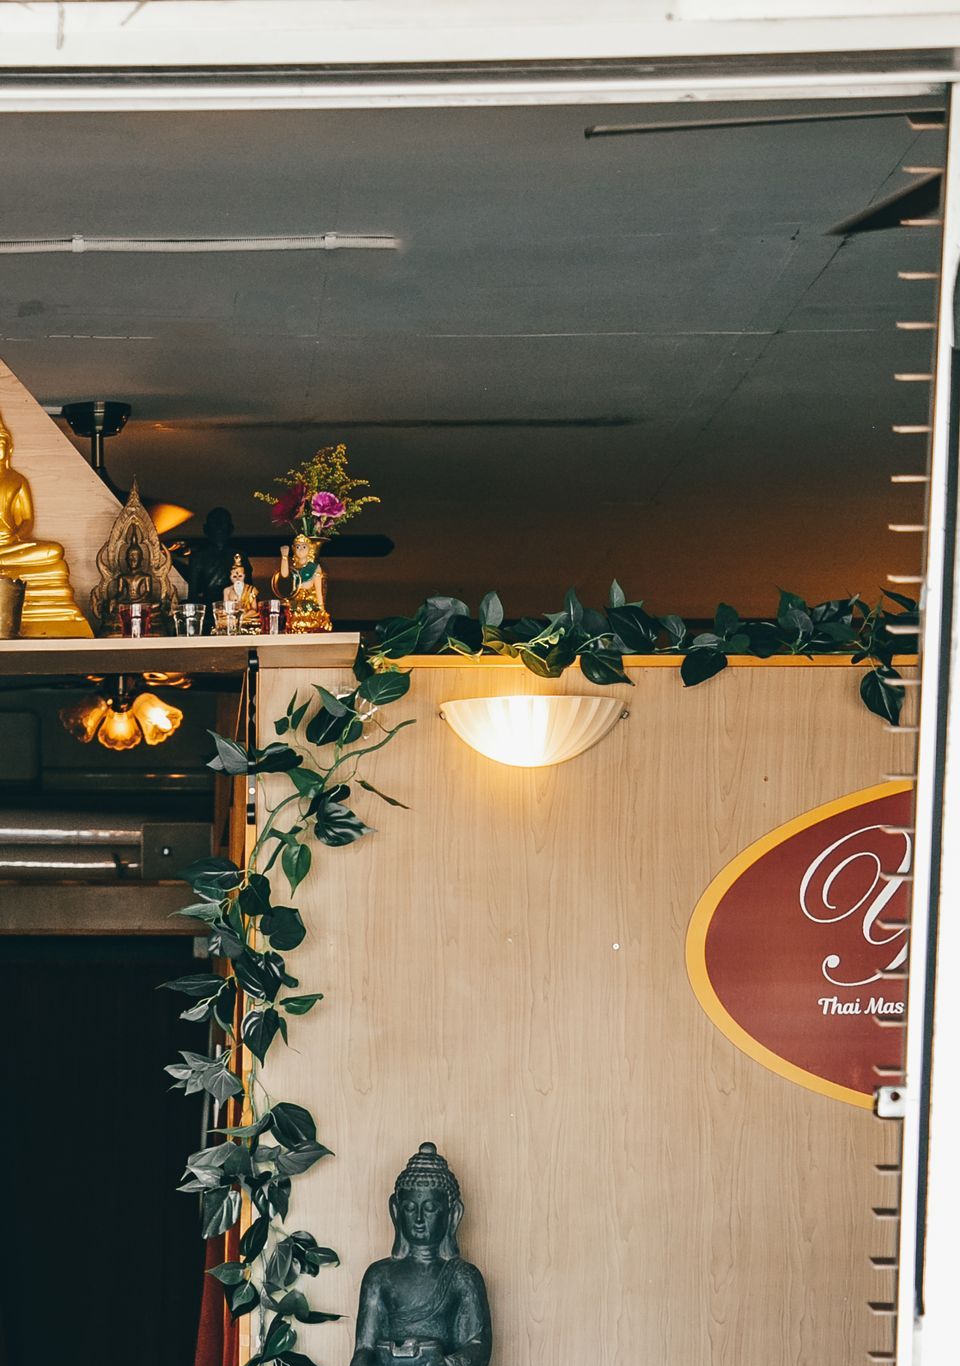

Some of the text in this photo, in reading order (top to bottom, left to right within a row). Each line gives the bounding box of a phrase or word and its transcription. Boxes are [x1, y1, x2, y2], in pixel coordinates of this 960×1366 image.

[799, 825, 912, 987] Y
[817, 996, 905, 1016] Thai Mas
